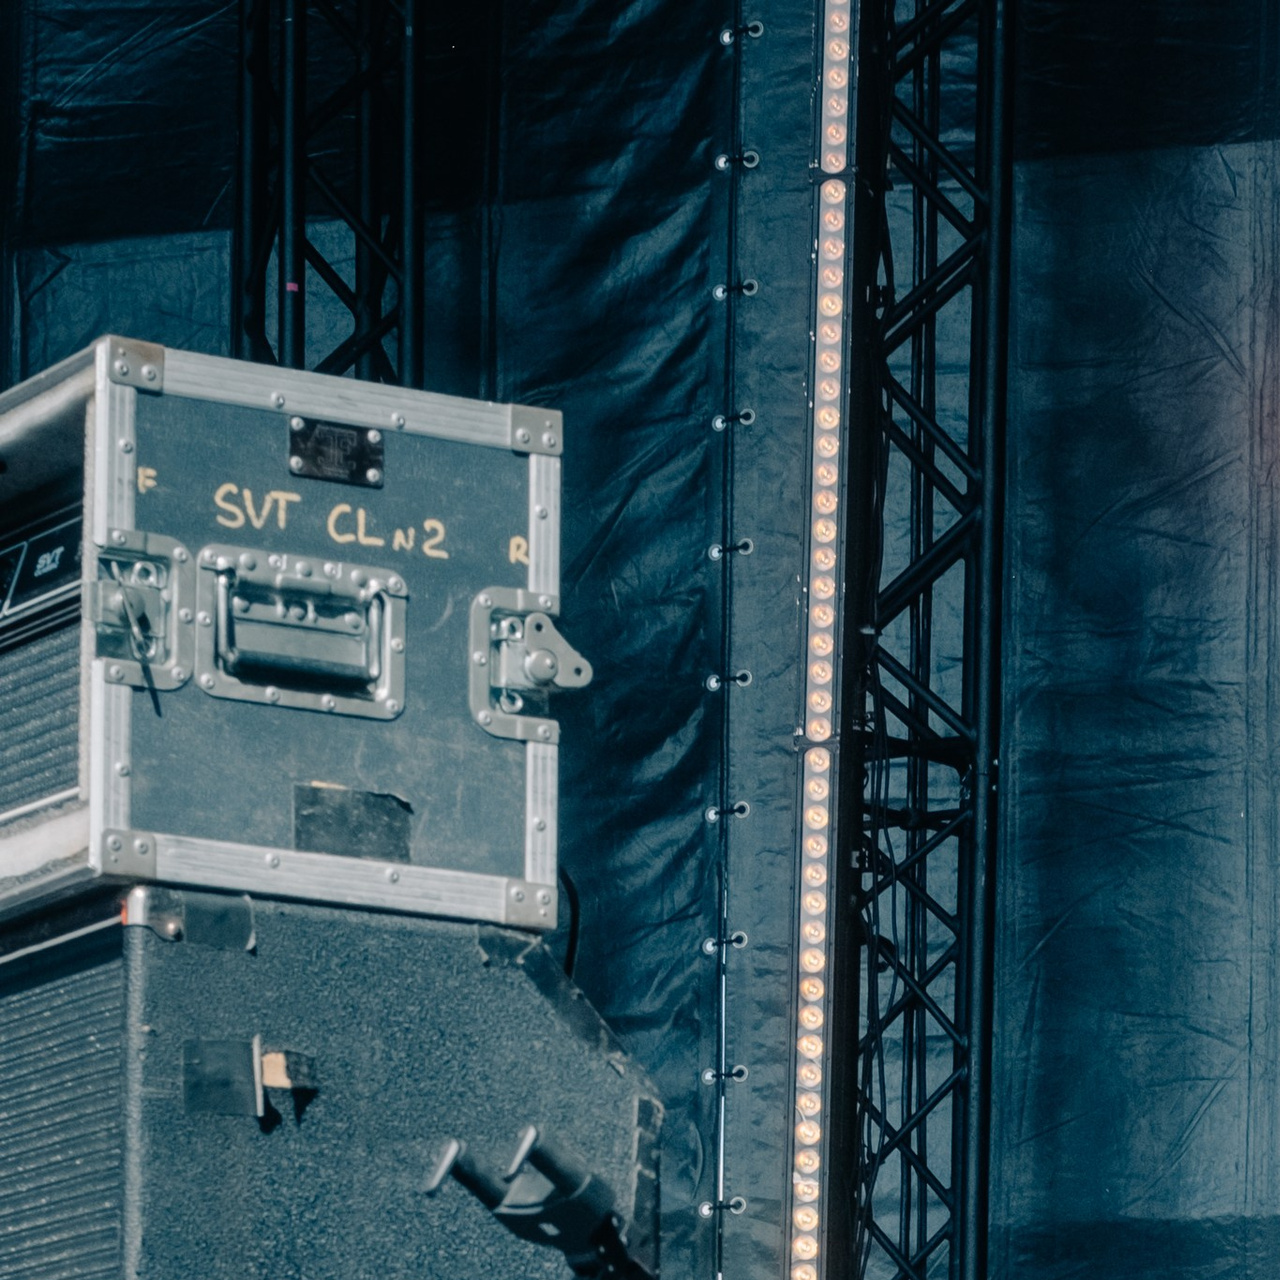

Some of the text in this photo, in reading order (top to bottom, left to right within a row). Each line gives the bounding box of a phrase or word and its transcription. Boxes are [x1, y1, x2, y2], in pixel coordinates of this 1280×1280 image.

[137, 466, 157, 494] F
[214, 482, 301, 530] SVT
[36, 546, 65, 569] SVT
[509, 535, 530, 566] R
